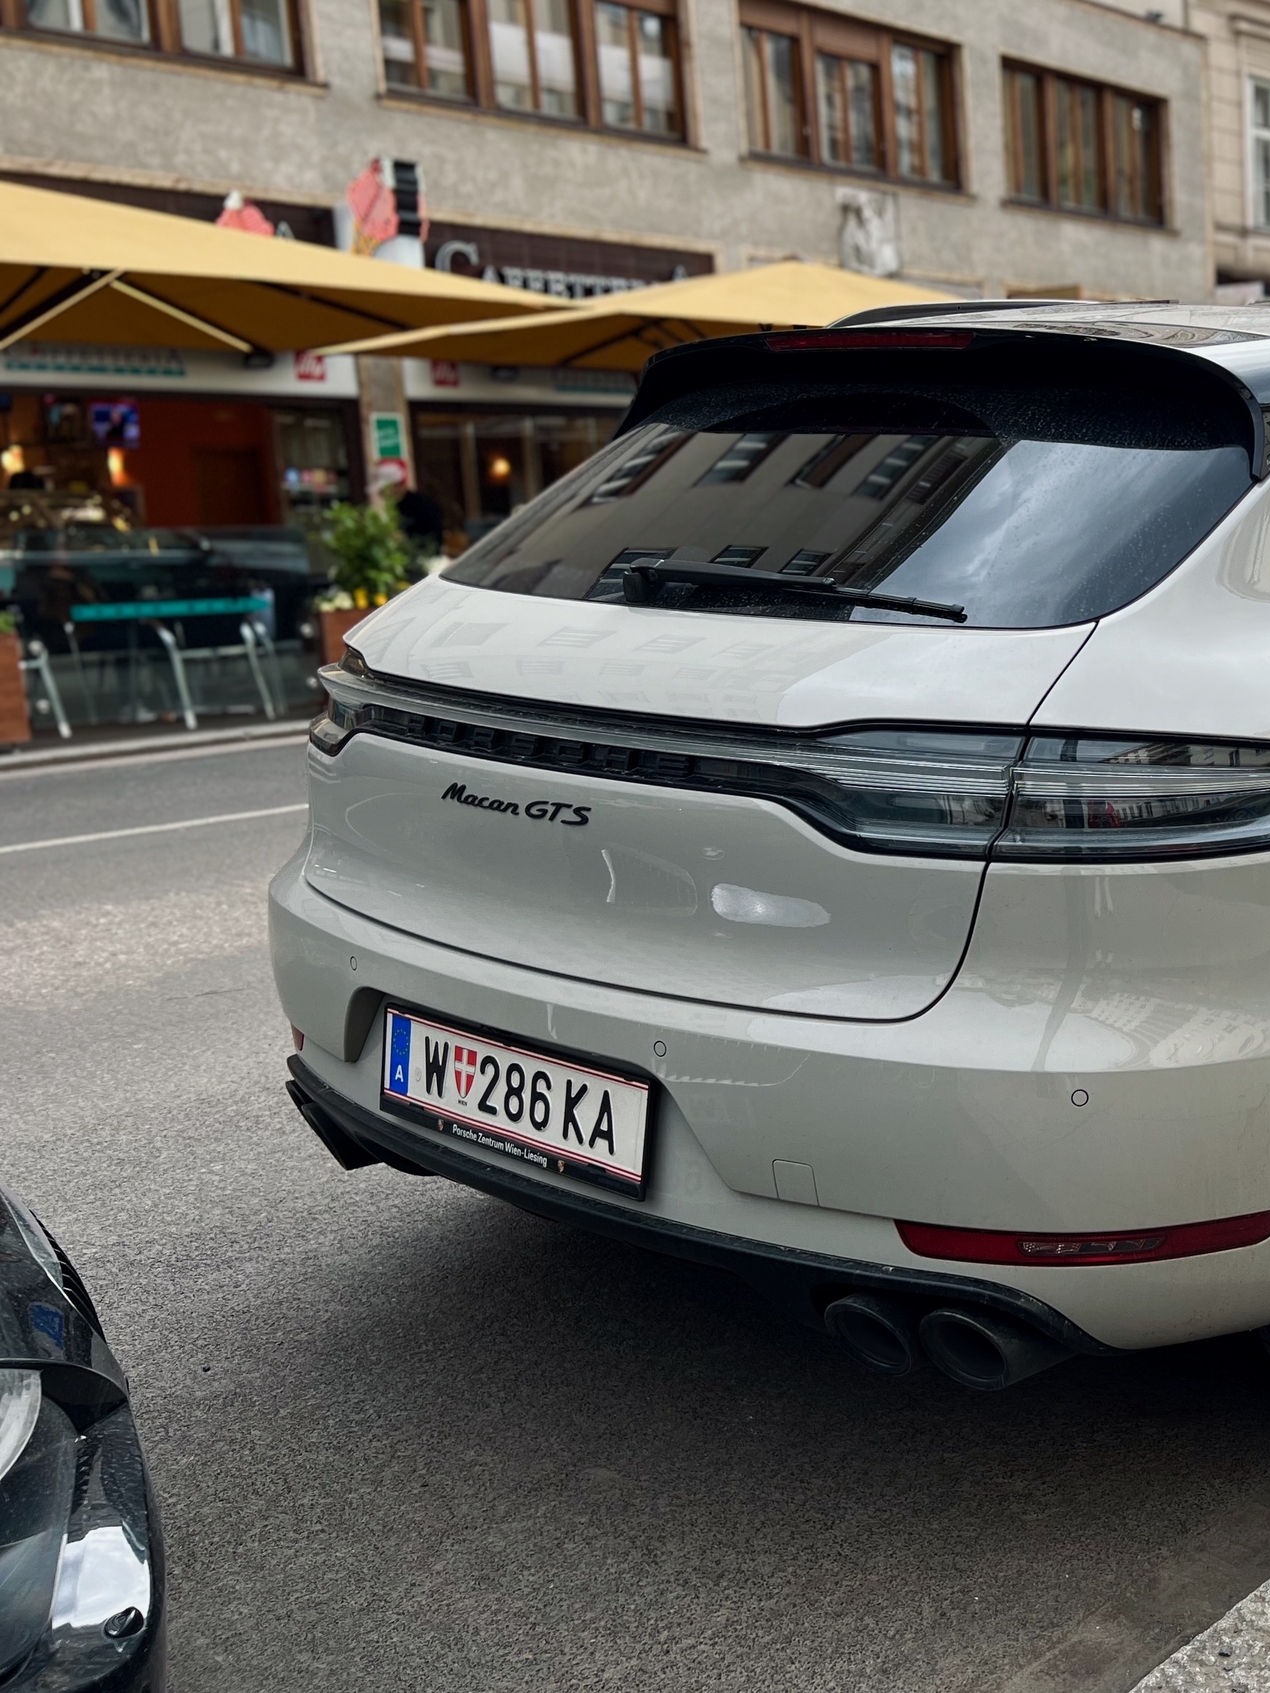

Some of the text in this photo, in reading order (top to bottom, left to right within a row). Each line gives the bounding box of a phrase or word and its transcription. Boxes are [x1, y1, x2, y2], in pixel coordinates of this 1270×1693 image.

[434, 240, 690, 299] CAFFETTE
[441, 782, 592, 826] Macan GTS
[394, 1064, 405, 1083] A
[424, 1035, 617, 1156] W 286 KA
[452, 1123, 548, 1168] Porsche Zentrum Wien-Liesing
